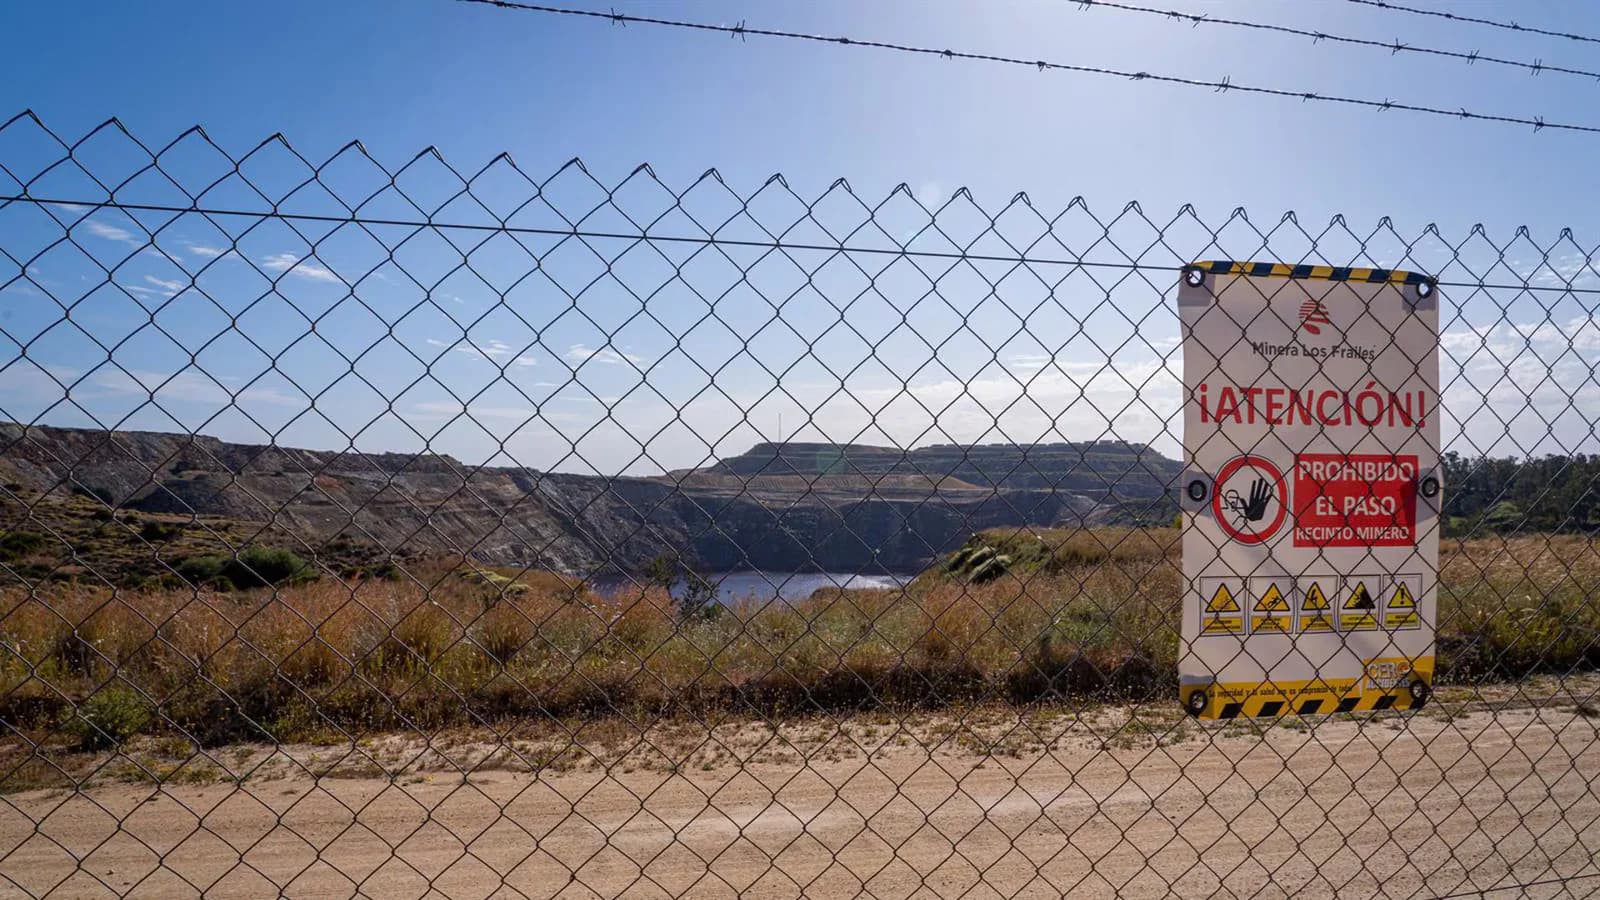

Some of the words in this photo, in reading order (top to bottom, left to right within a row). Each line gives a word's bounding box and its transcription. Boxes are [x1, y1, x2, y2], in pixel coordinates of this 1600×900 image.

[1252, 341, 1298, 357] Minera
[1303, 344, 1327, 358] Los
[1332, 345, 1375, 360] Frailes
[1199, 381, 1426, 428] ¡ATENCIÓN!
[1298, 460, 1414, 482] PROHIBIDO
[1315, 496, 1333, 516] EL
[1344, 496, 1396, 516] PASO
[1296, 526, 1353, 541] RECINTO
[1357, 526, 1409, 540] MINERO
